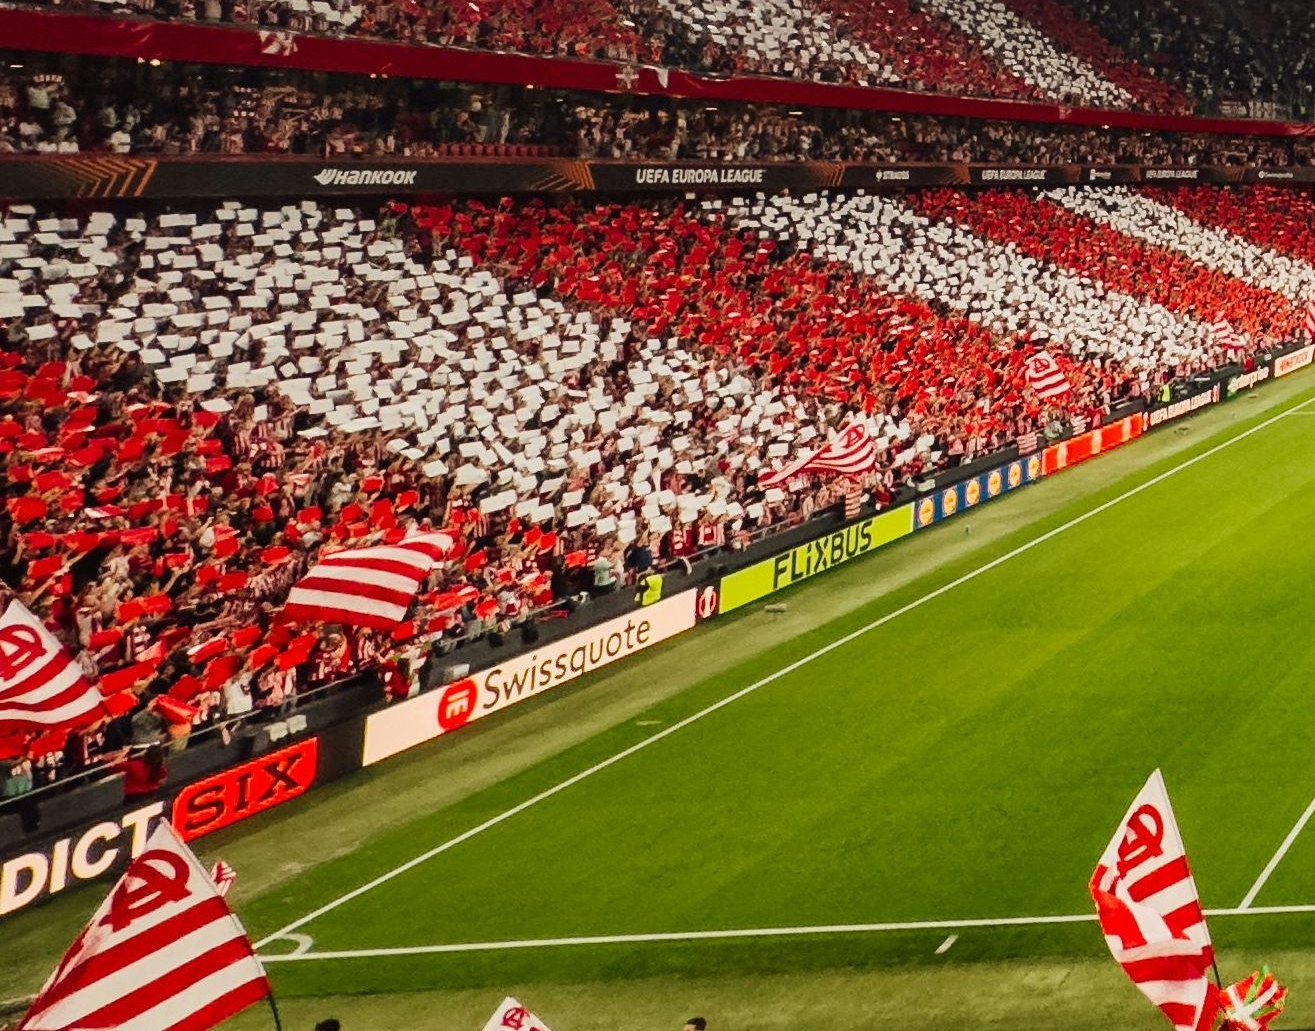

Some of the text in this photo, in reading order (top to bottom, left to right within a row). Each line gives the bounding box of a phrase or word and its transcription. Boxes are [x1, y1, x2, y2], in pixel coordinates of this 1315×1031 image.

[637, 169, 763, 183] UEFA EUROPA LEAGUE
[483, 619, 650, 709] Swissquote
[185, 752, 303, 830] SIX
